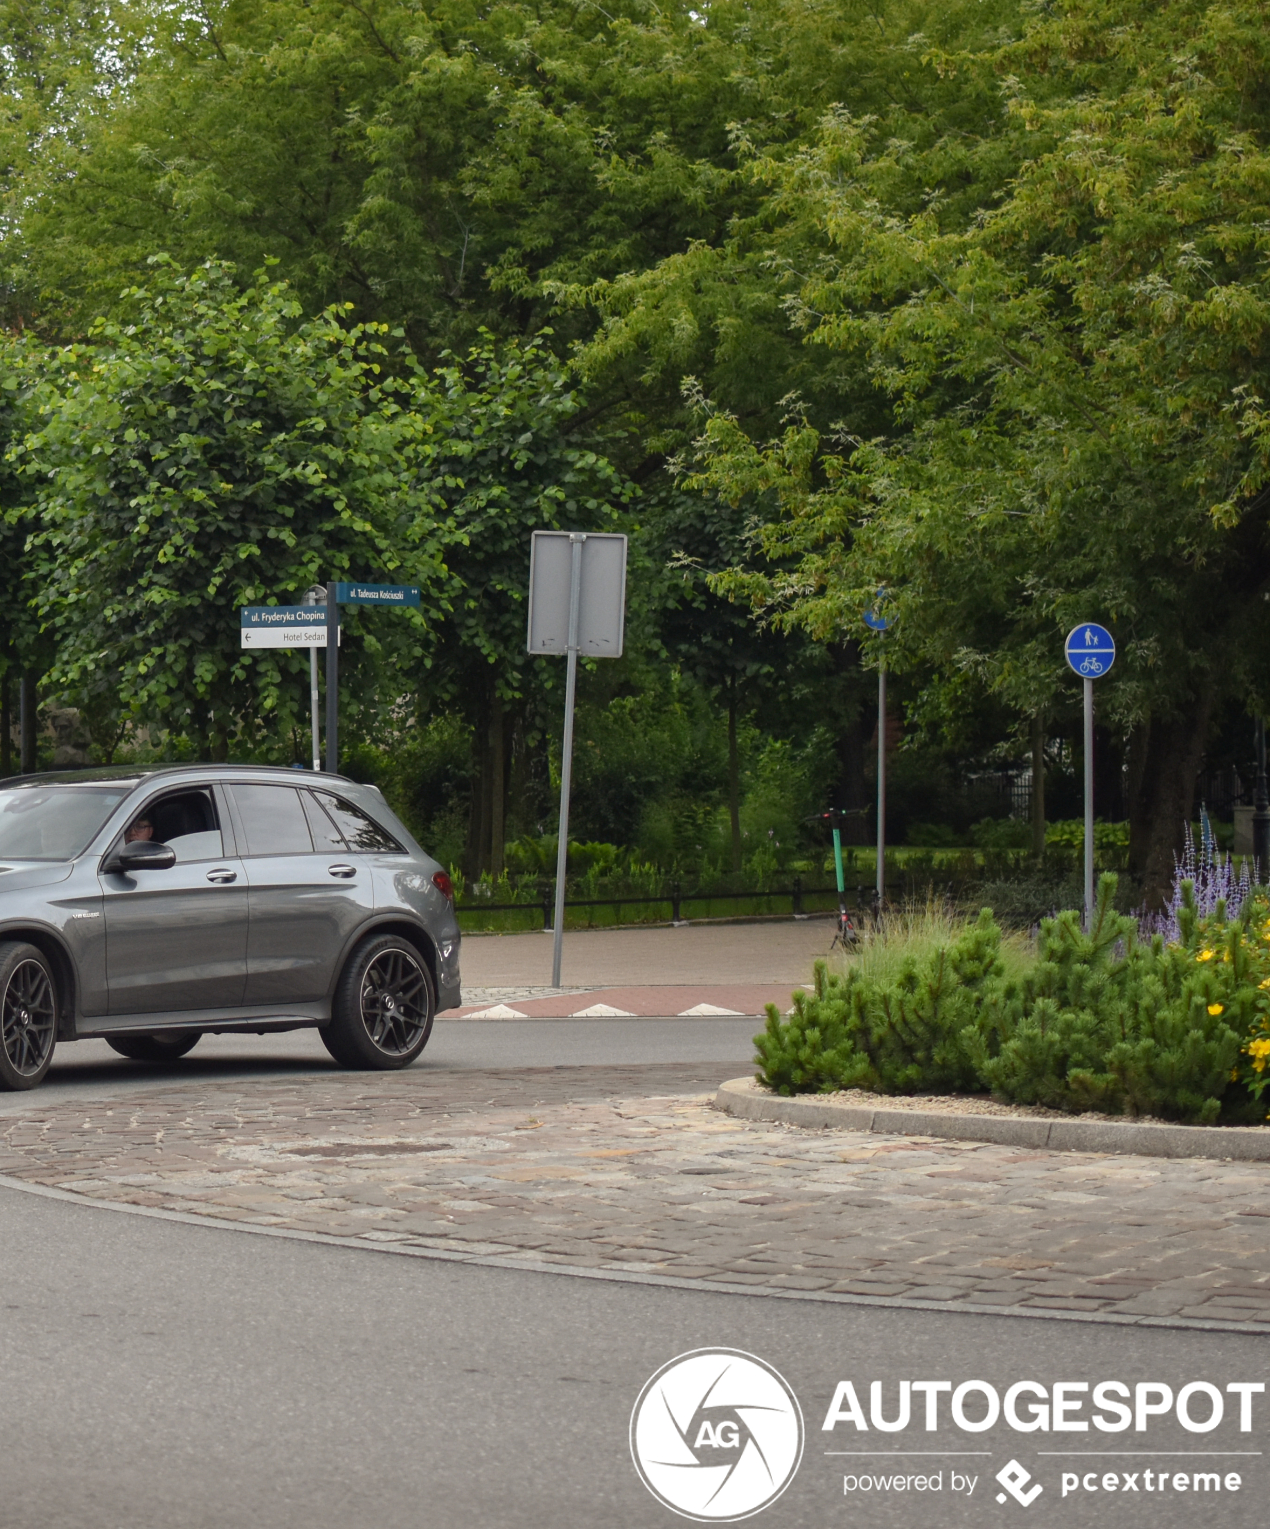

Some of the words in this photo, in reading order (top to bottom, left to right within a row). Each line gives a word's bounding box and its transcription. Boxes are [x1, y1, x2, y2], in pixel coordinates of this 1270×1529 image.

[358, 588, 379, 599] Tadeusza
[380, 590, 404, 600] Kościuszki
[251, 613, 260, 622] ul.
[261, 611, 295, 624] Fryderyka
[296, 610, 325, 622] Chopina
[283, 632, 303, 642] Hotel
[303, 631, 326, 641] Sedan
